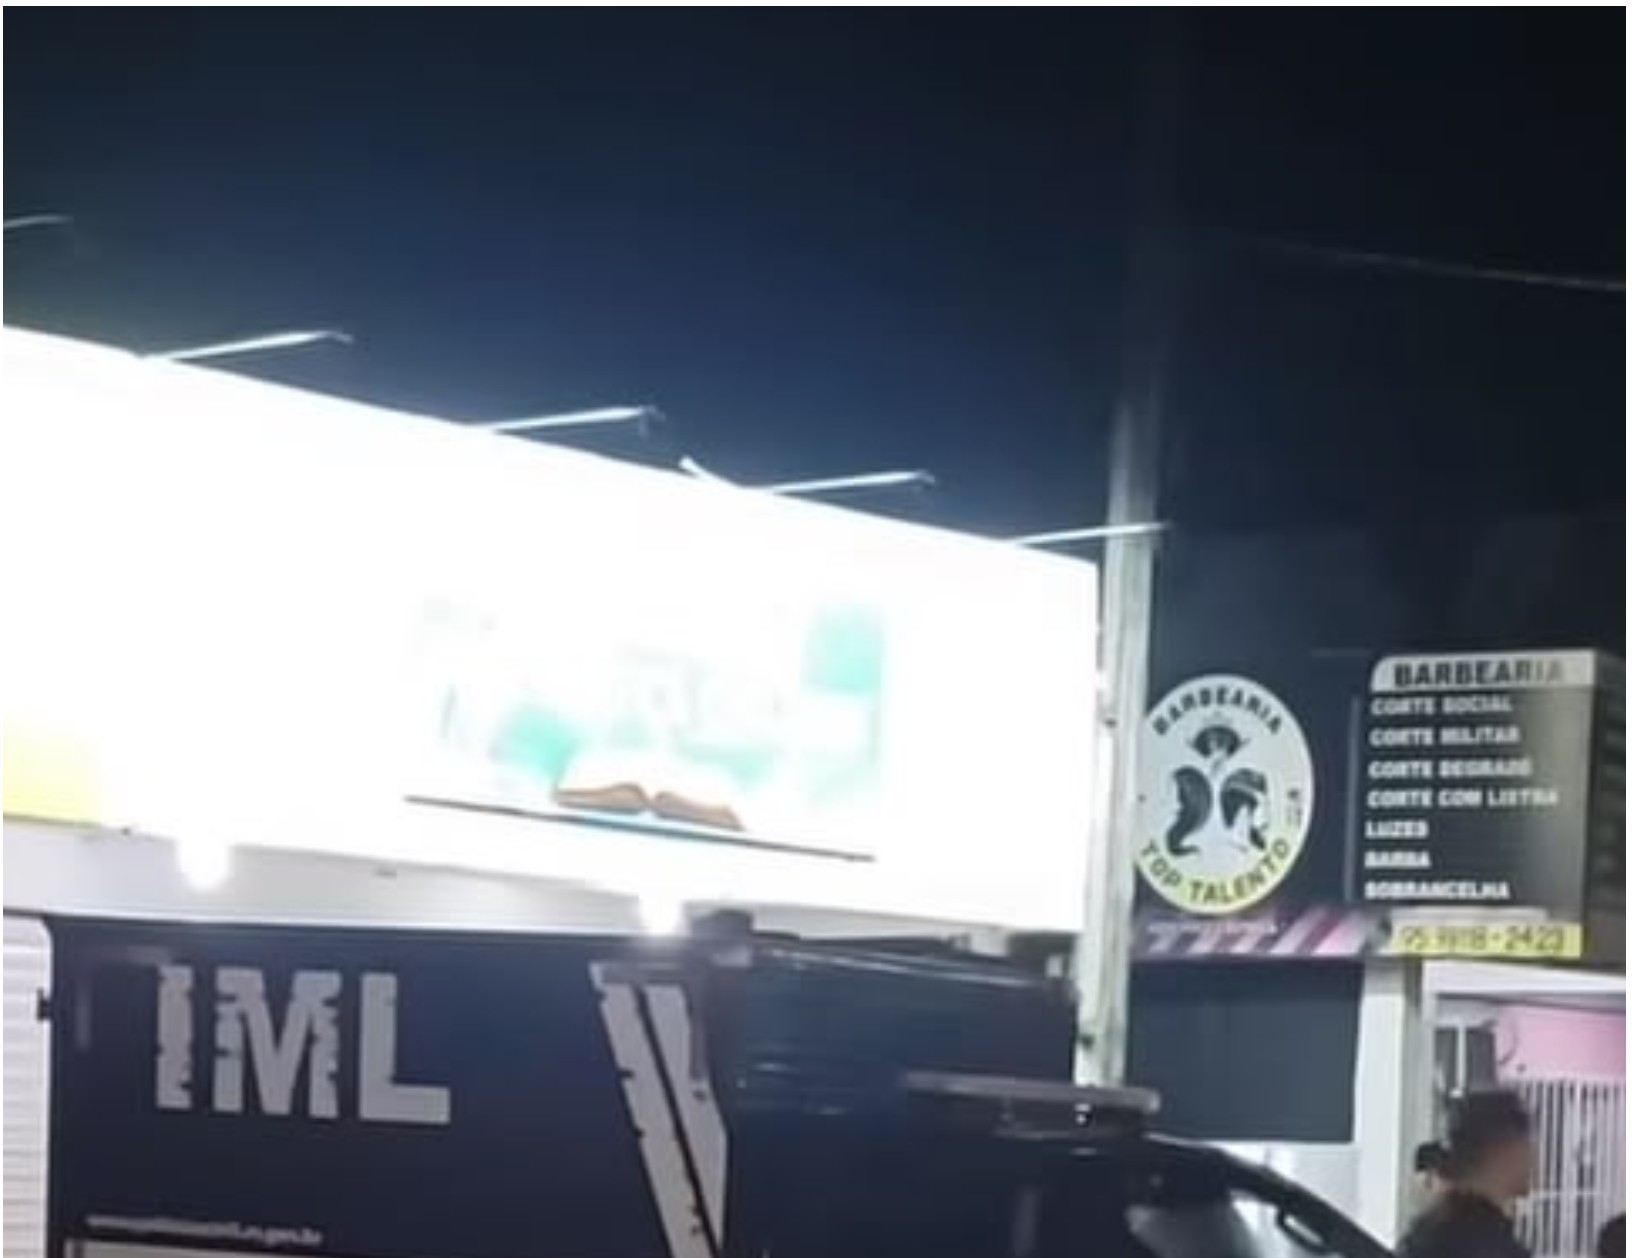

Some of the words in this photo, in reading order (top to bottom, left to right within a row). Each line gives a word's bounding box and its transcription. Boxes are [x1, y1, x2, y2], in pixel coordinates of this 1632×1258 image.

[1394, 660, 1564, 687] BARBEARIA
[1153, 685, 1282, 735] BARBEARIA
[1370, 696, 1435, 715] CORTE
[1441, 694, 1513, 714] SOCIAL
[1369, 727, 1434, 746] CORTE
[1440, 725, 1520, 745] MILITAR
[1368, 760, 1433, 778] CORTE
[1367, 790, 1433, 808] CORTE
[1438, 788, 1483, 807] COM
[1487, 786, 1558, 807] LISTRA
[1365, 819, 1429, 839] LUZES
[1364, 850, 1431, 869] BARBA
[1141, 841, 1182, 887] TOP
[1190, 838, 1290, 904] TALENTO
[1364, 880, 1511, 899] SOBRANCELHA
[155, 962, 452, 1126] IML
